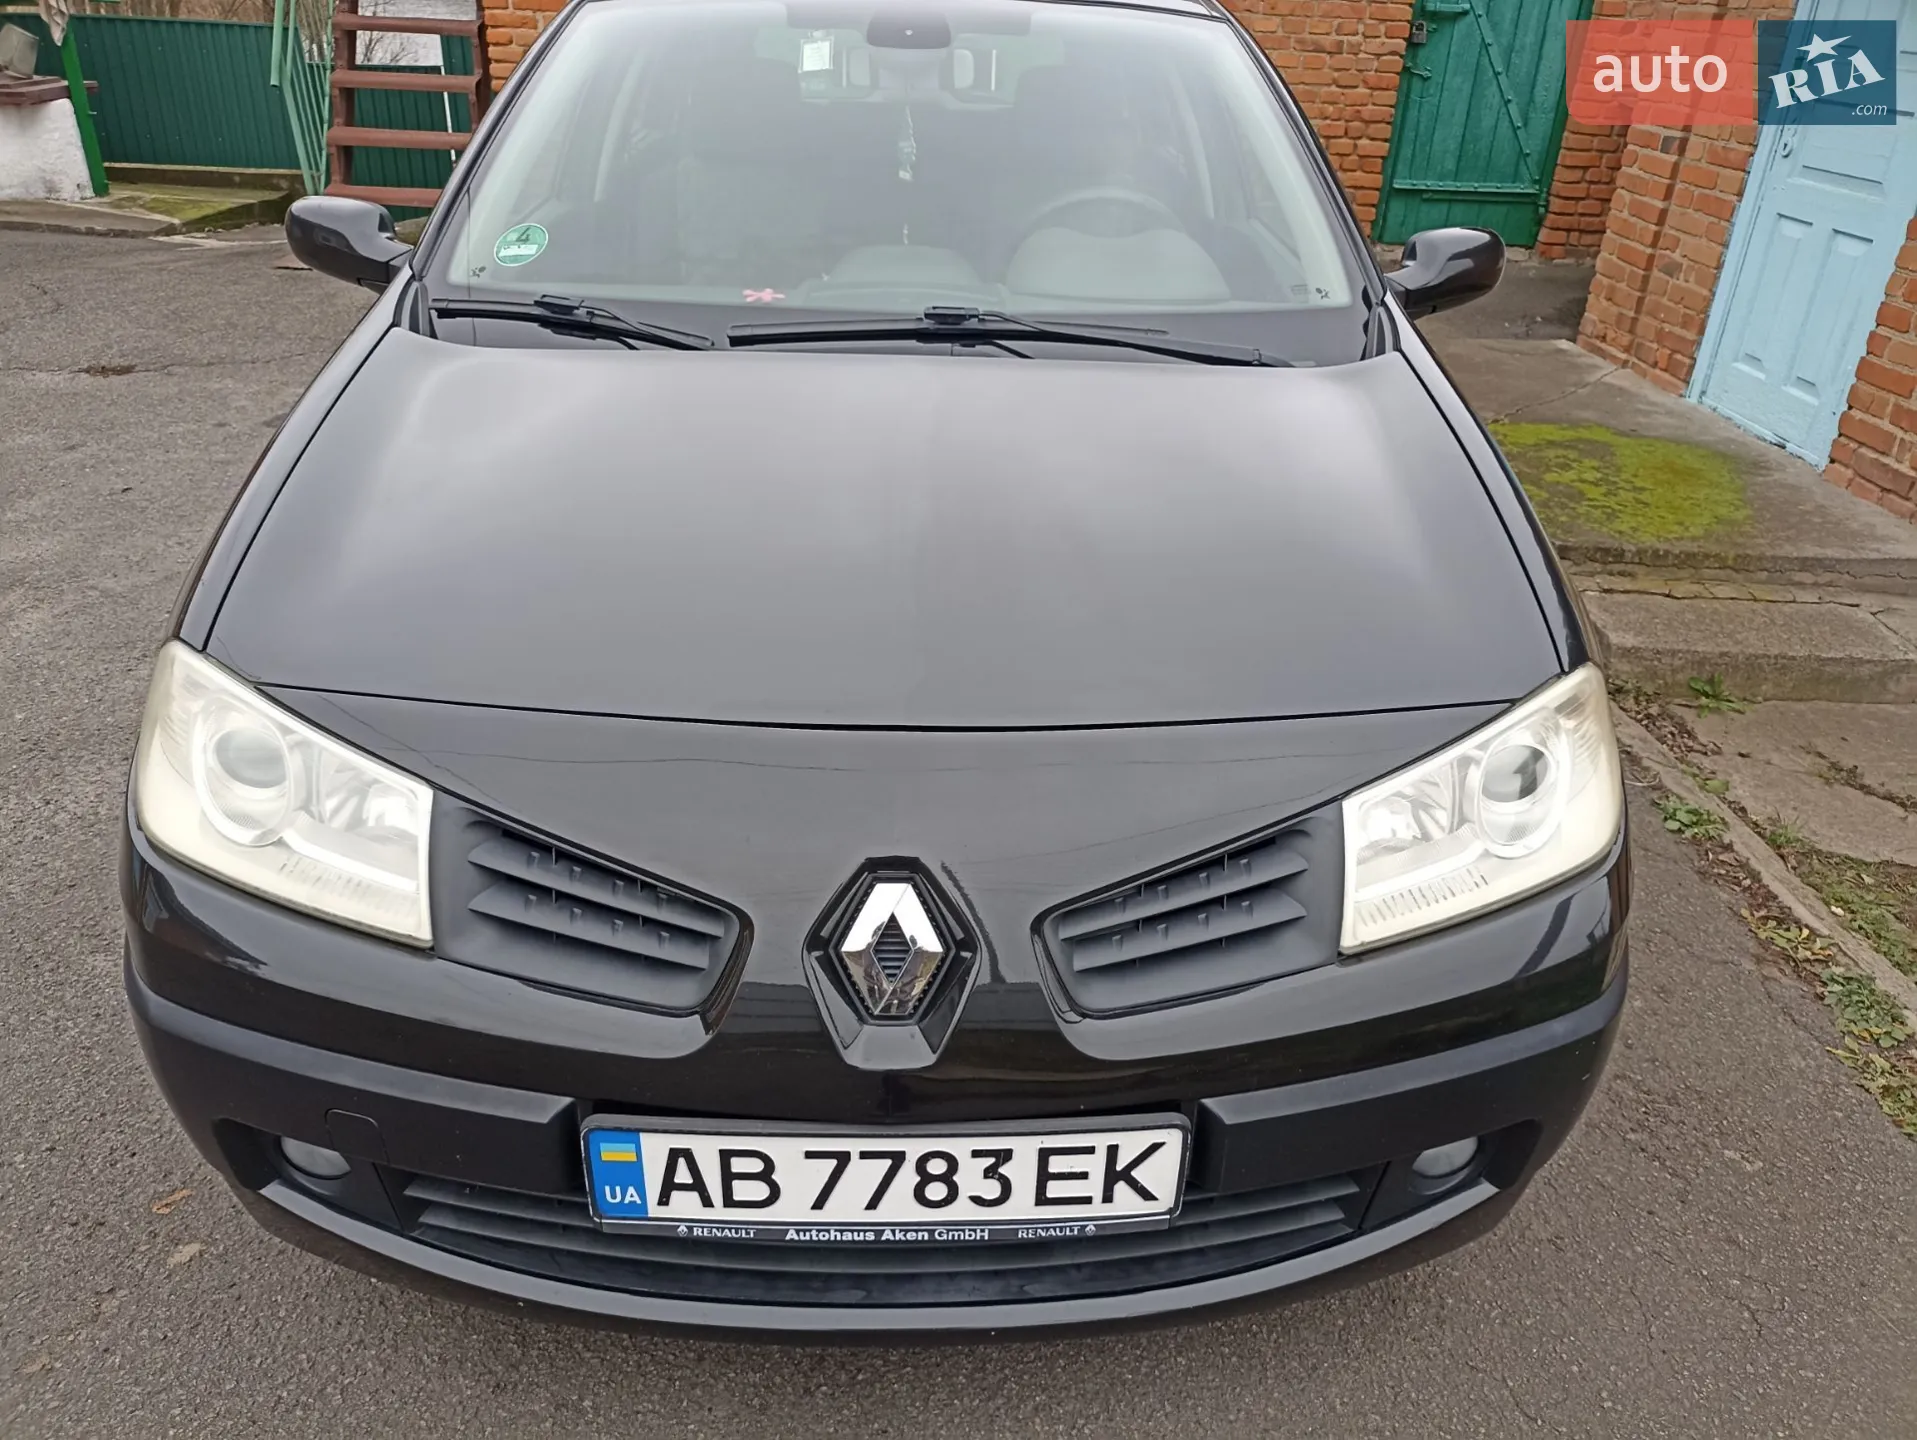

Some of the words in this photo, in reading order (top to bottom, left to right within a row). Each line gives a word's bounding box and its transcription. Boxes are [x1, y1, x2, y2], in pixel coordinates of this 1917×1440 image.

[657, 1147, 782, 1209] AB
[804, 1148, 1013, 1210] 7783
[1033, 1140, 1167, 1207] EK
[604, 1185, 642, 1205] UA
[693, 1227, 757, 1239] RENAULT
[785, 1229, 876, 1242] Autohaus
[881, 1228, 929, 1241] Aken
[934, 1228, 989, 1241] GmbH
[1018, 1226, 1081, 1239] RENAULT
